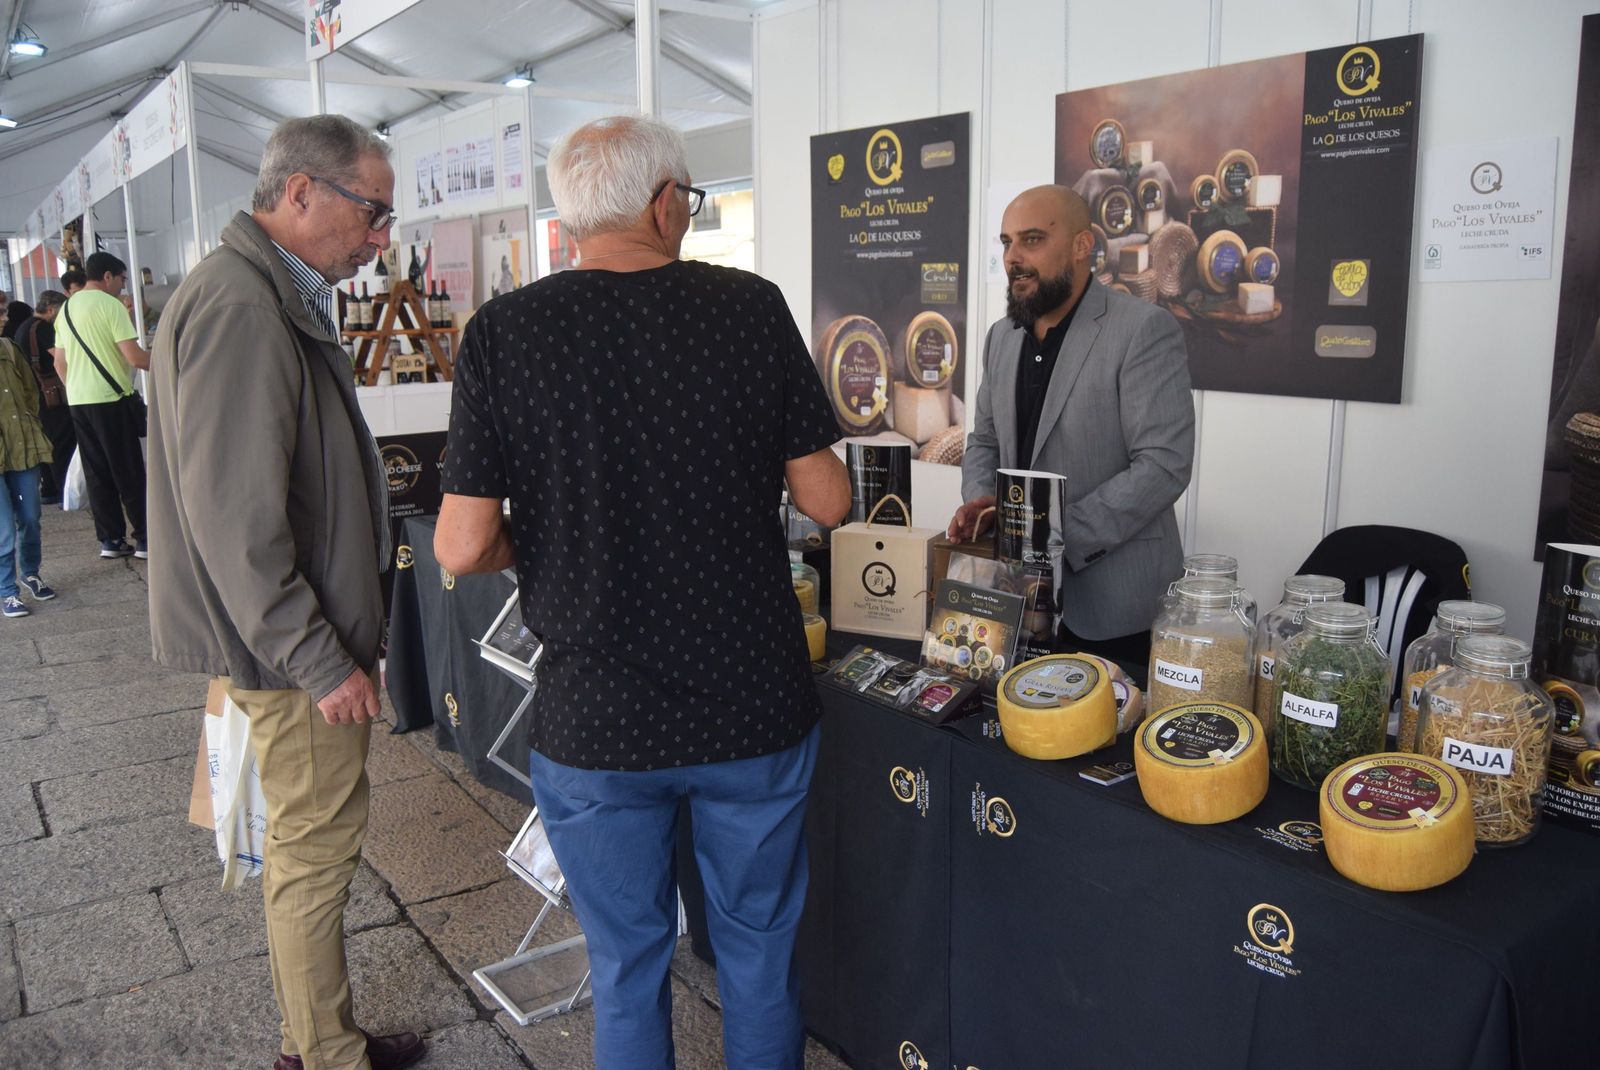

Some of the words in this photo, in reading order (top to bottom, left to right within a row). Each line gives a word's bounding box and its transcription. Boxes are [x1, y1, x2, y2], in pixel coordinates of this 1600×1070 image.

[1334, 98, 1354, 107] QUESO
[1304, 114, 1328, 125] PAGO
[1312, 137, 1324, 146] LA
[1336, 134, 1346, 143] DE
[1349, 132, 1365, 142] LOS
[1366, 129, 1400, 140] QUESOS
[840, 205, 861, 218] PAGO
[1453, 203, 1480, 214] QUESO
[1494, 200, 1520, 210] OVEJA
[1432, 218, 1456, 228] PAGO
[850, 234, 858, 243] LA
[868, 232, 878, 242] DE
[878, 232, 892, 242] LOS
[892, 230, 922, 242] QUESOS
[1528, 248, 1542, 256] IFS
[1563, 584, 1590, 598] QUESO
[1568, 614, 1590, 626] LECHE
[1157, 666, 1200, 684] MEZCLA
[1284, 700, 1334, 720] ALFALFA
[1197, 721, 1218, 731] PAGO
[1448, 744, 1504, 769] PAJA
[1388, 774, 1412, 786] PAGO
[1368, 786, 1390, 796] LECHE
[1391, 790, 1415, 801] CRUDA
[1546, 783, 1581, 799] MEJORES
[1582, 794, 1600, 804] DEL
[1556, 795, 1571, 806] LOS
